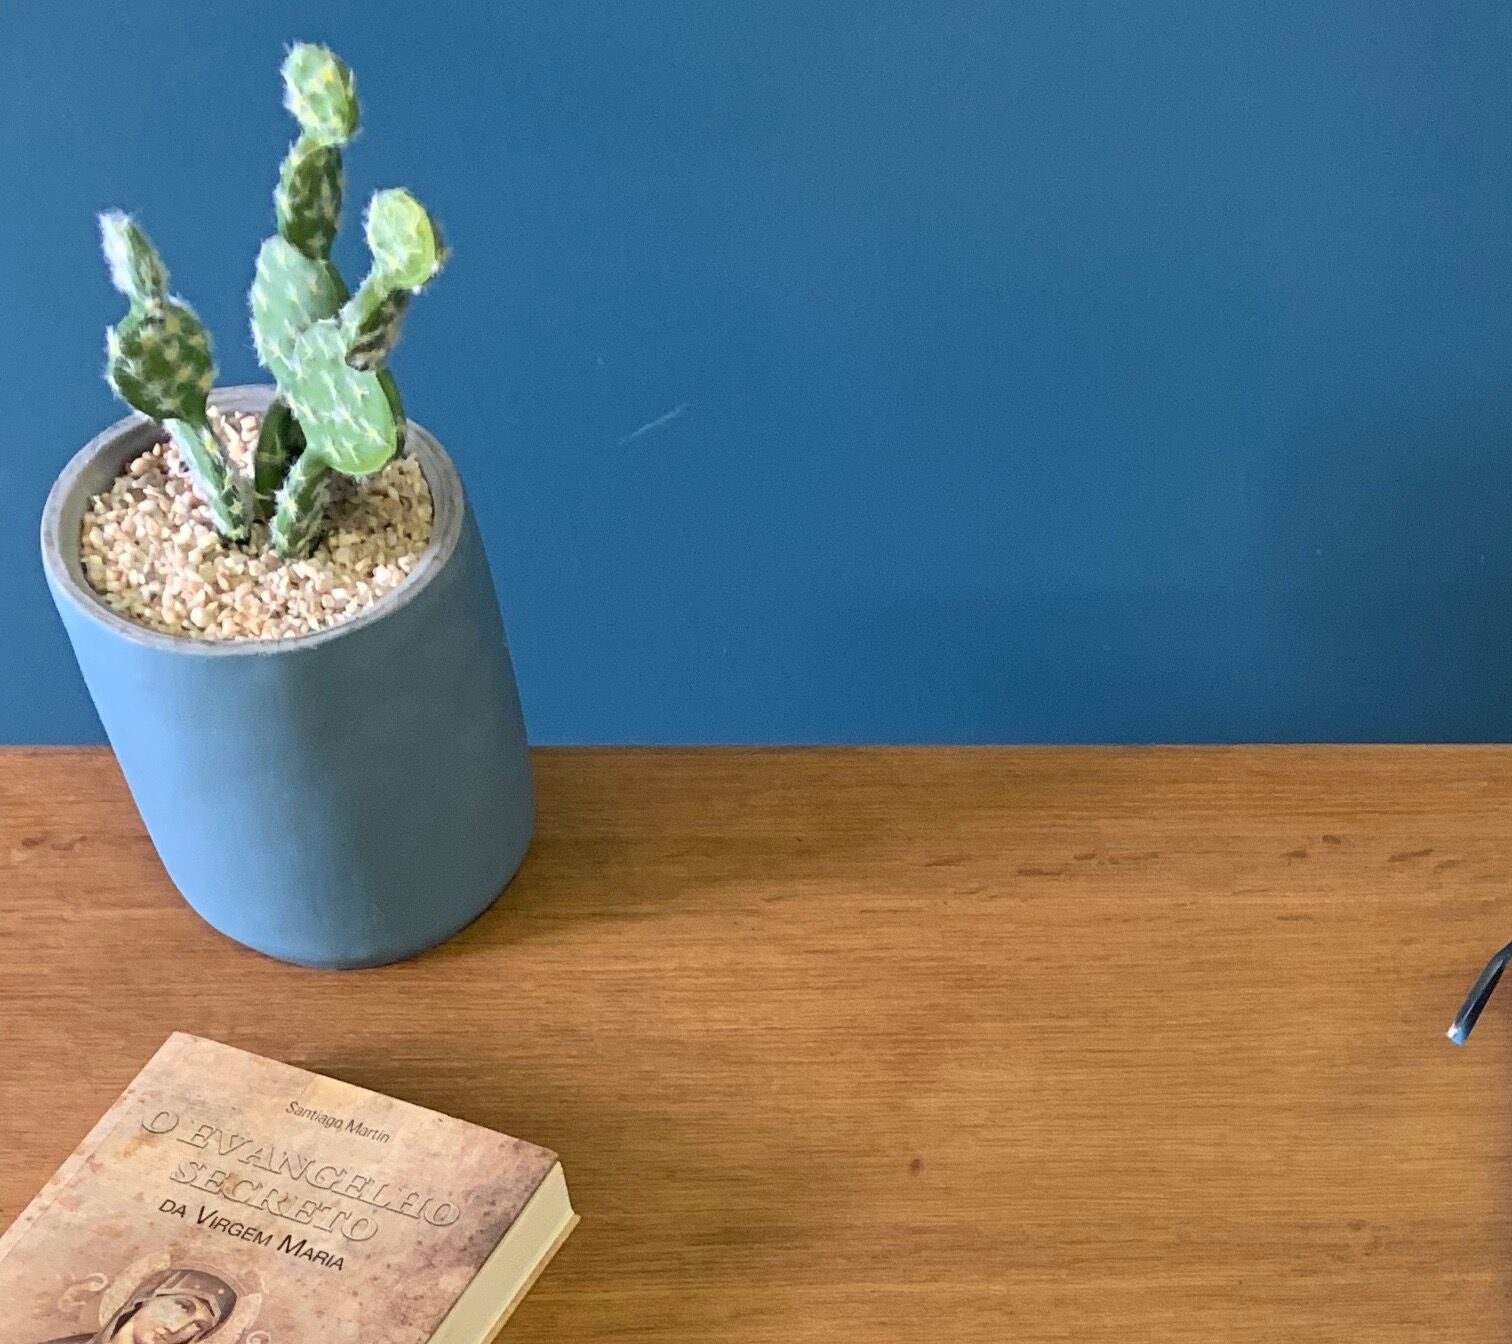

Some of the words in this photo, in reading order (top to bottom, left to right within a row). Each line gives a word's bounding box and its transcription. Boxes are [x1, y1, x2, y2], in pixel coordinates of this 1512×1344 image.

[284, 1100, 344, 1129] Santiago
[141, 1110, 180, 1135] O
[175, 1122, 462, 1228] EVANGELHO
[158, 1198, 188, 1219] DA
[168, 1160, 380, 1243] SECRETO
